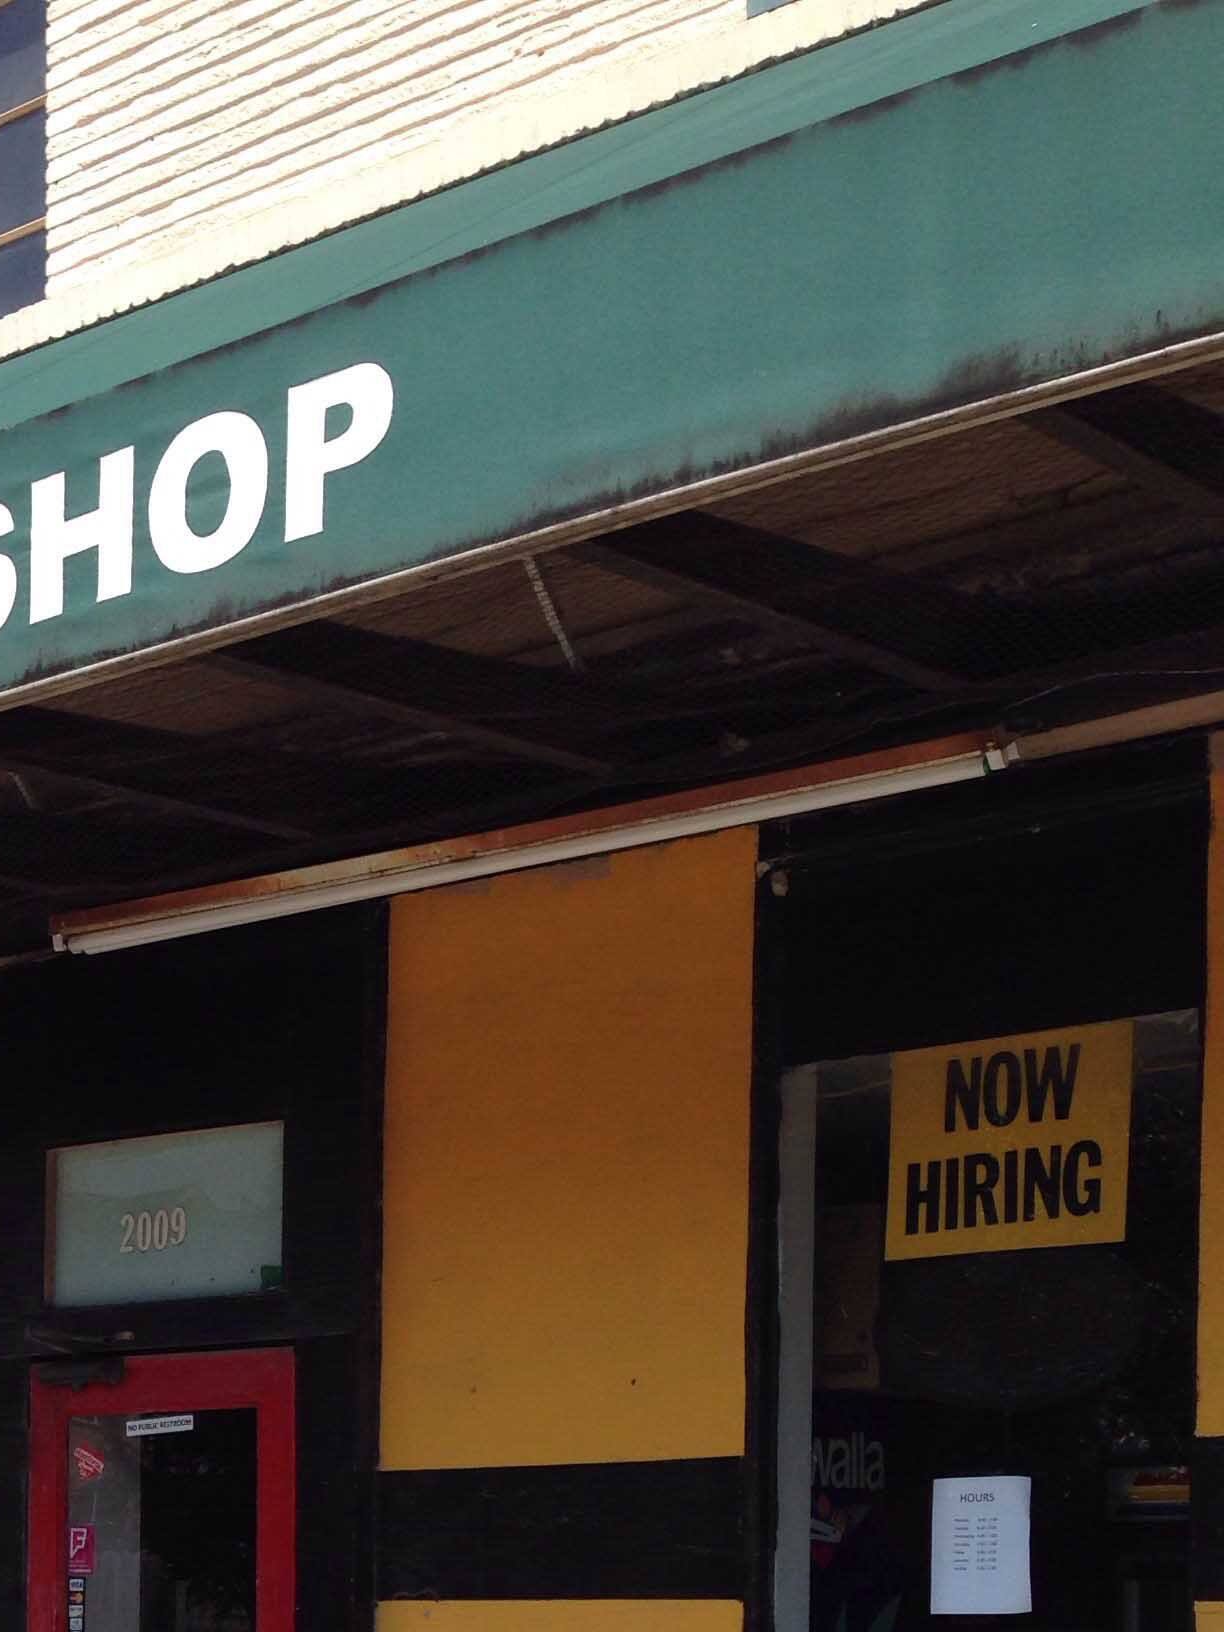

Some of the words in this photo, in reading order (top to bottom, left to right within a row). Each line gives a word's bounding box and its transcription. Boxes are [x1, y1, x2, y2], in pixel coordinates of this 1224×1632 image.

[944, 1043, 1081, 1132] NOW
[905, 1140, 1102, 1235] HIRING
[119, 1207, 188, 1253] 2009
[127, 1424, 137, 1432] NO
[959, 1492, 995, 1503] HOURS
